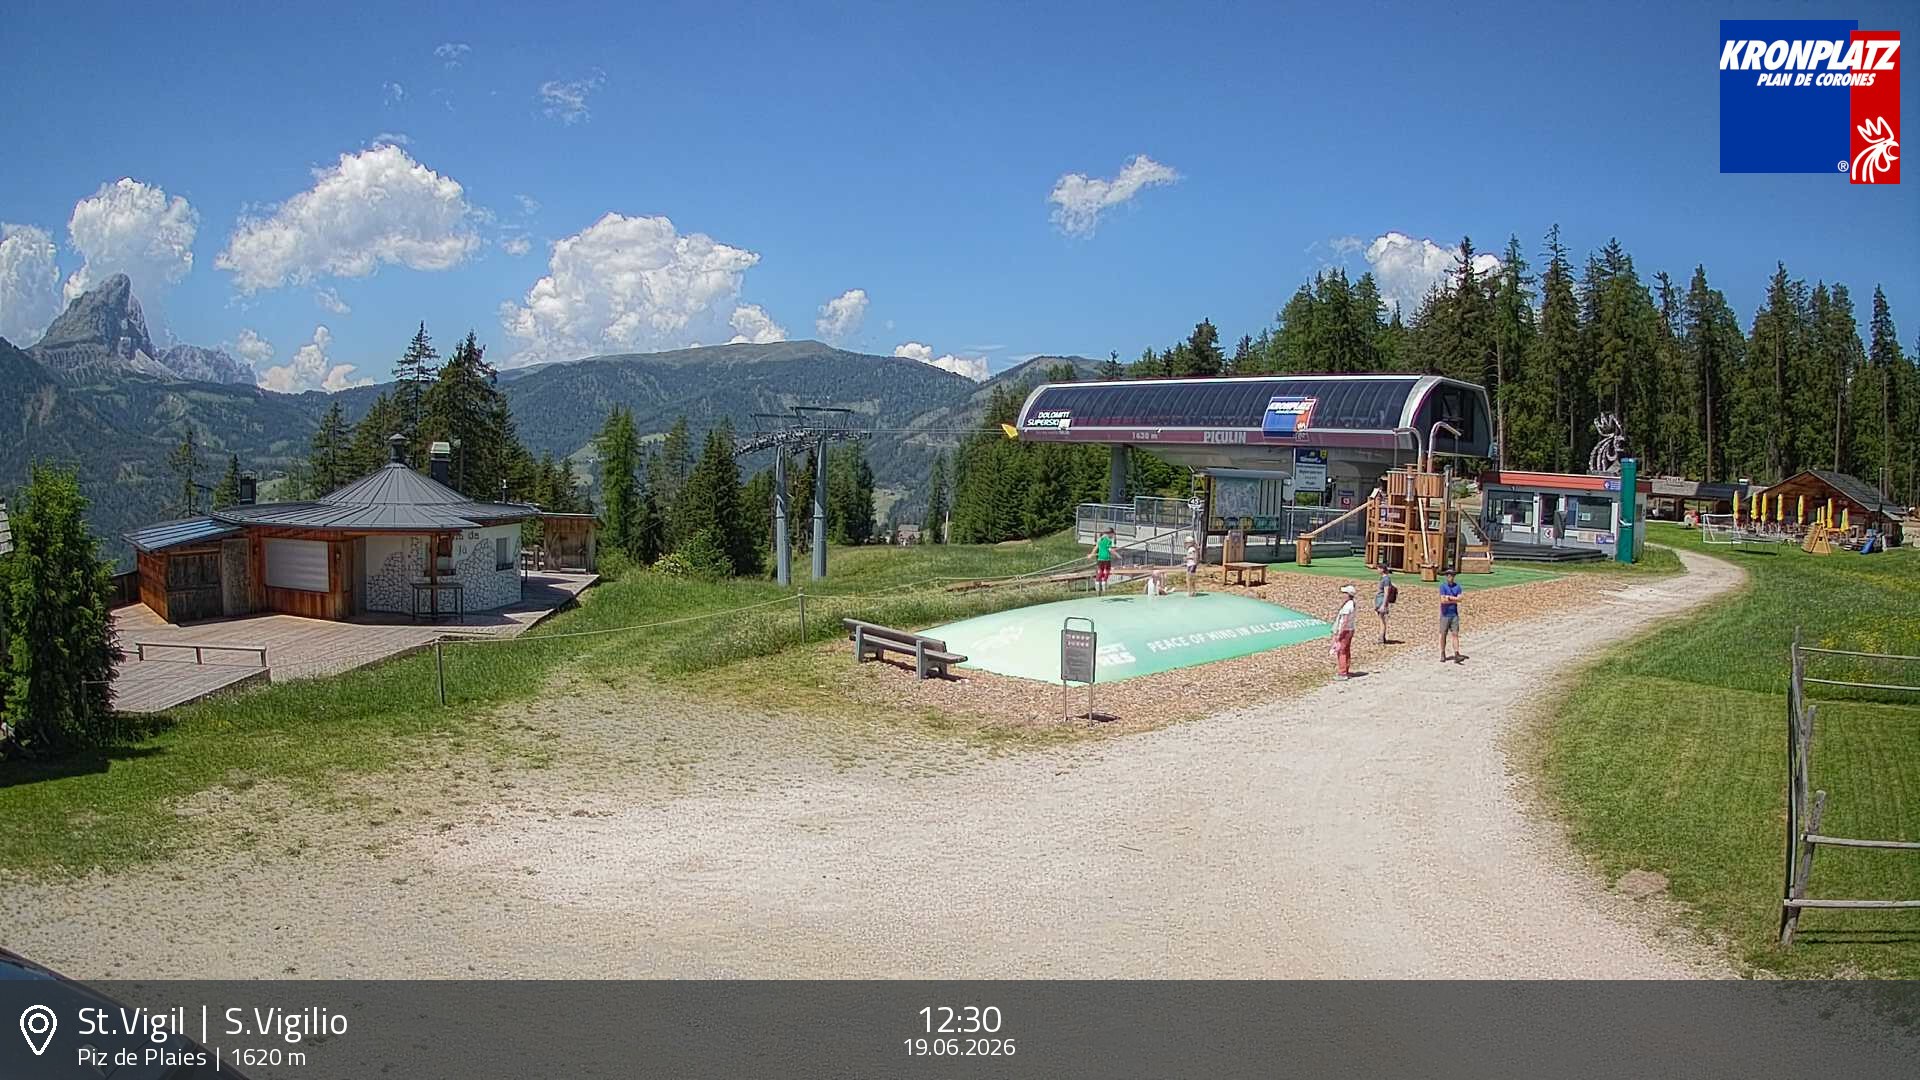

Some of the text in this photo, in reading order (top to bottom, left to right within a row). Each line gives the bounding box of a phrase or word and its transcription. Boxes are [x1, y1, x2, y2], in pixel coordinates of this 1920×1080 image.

[1038, 411, 1070, 419] DOLOMITI
[1203, 431, 1247, 444] PICULIN
[1147, 636, 1190, 653] PEACE
[1189, 632, 1205, 645] OF
[1206, 628, 1238, 641] MIND
[1249, 624, 1272, 634] ALL
